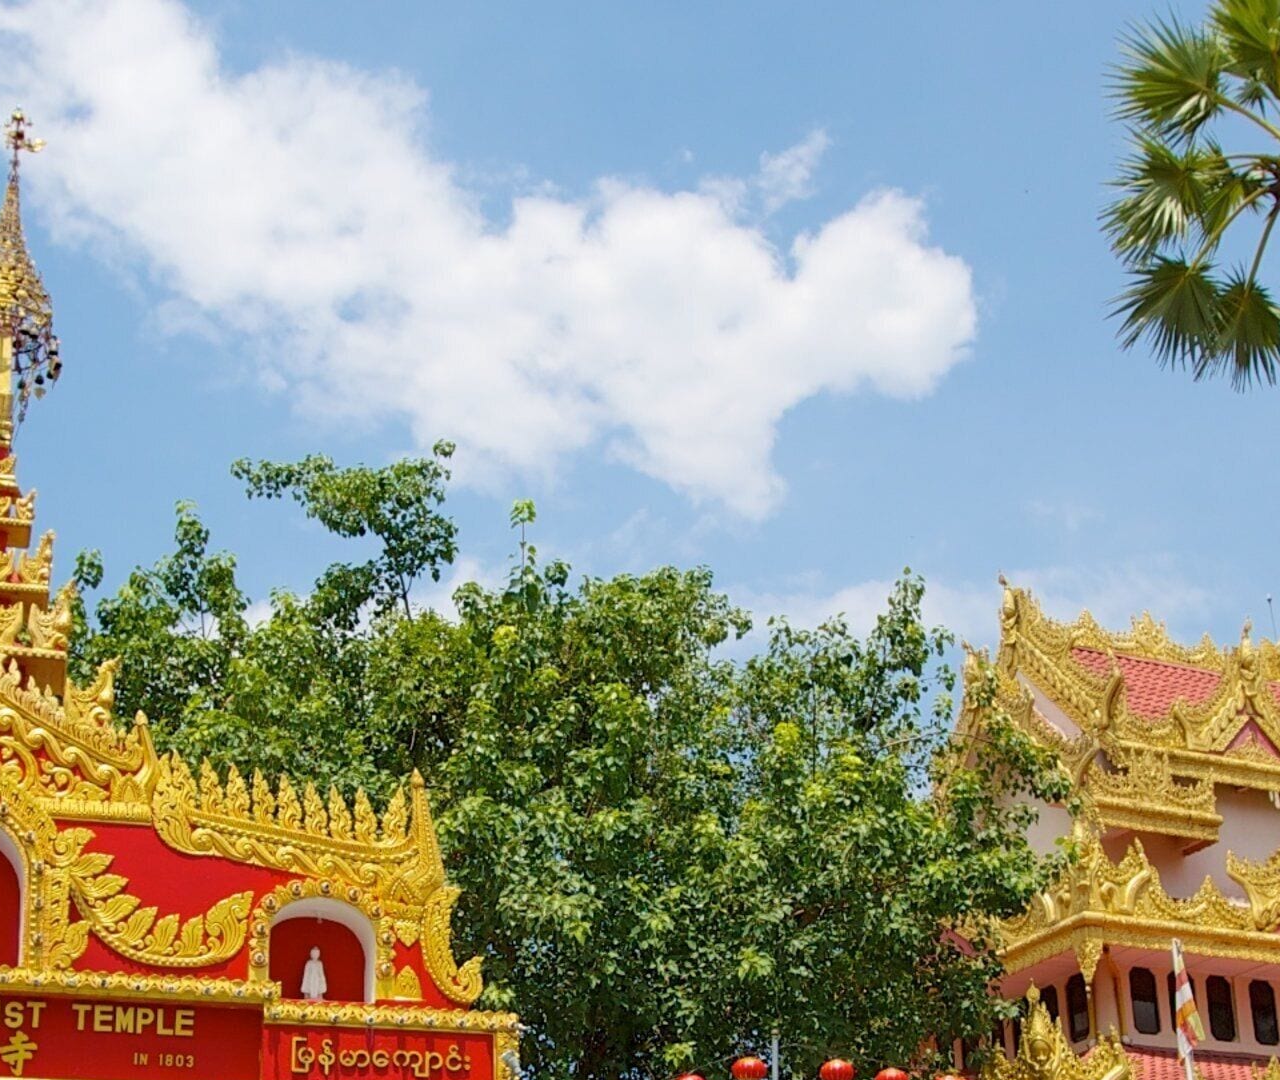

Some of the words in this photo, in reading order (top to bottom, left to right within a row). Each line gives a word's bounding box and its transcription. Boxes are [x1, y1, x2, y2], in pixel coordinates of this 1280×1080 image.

[72, 1003, 195, 1037] TEMPLE
[133, 1052, 149, 1066] IN
[158, 1053, 195, 1069] 1803
